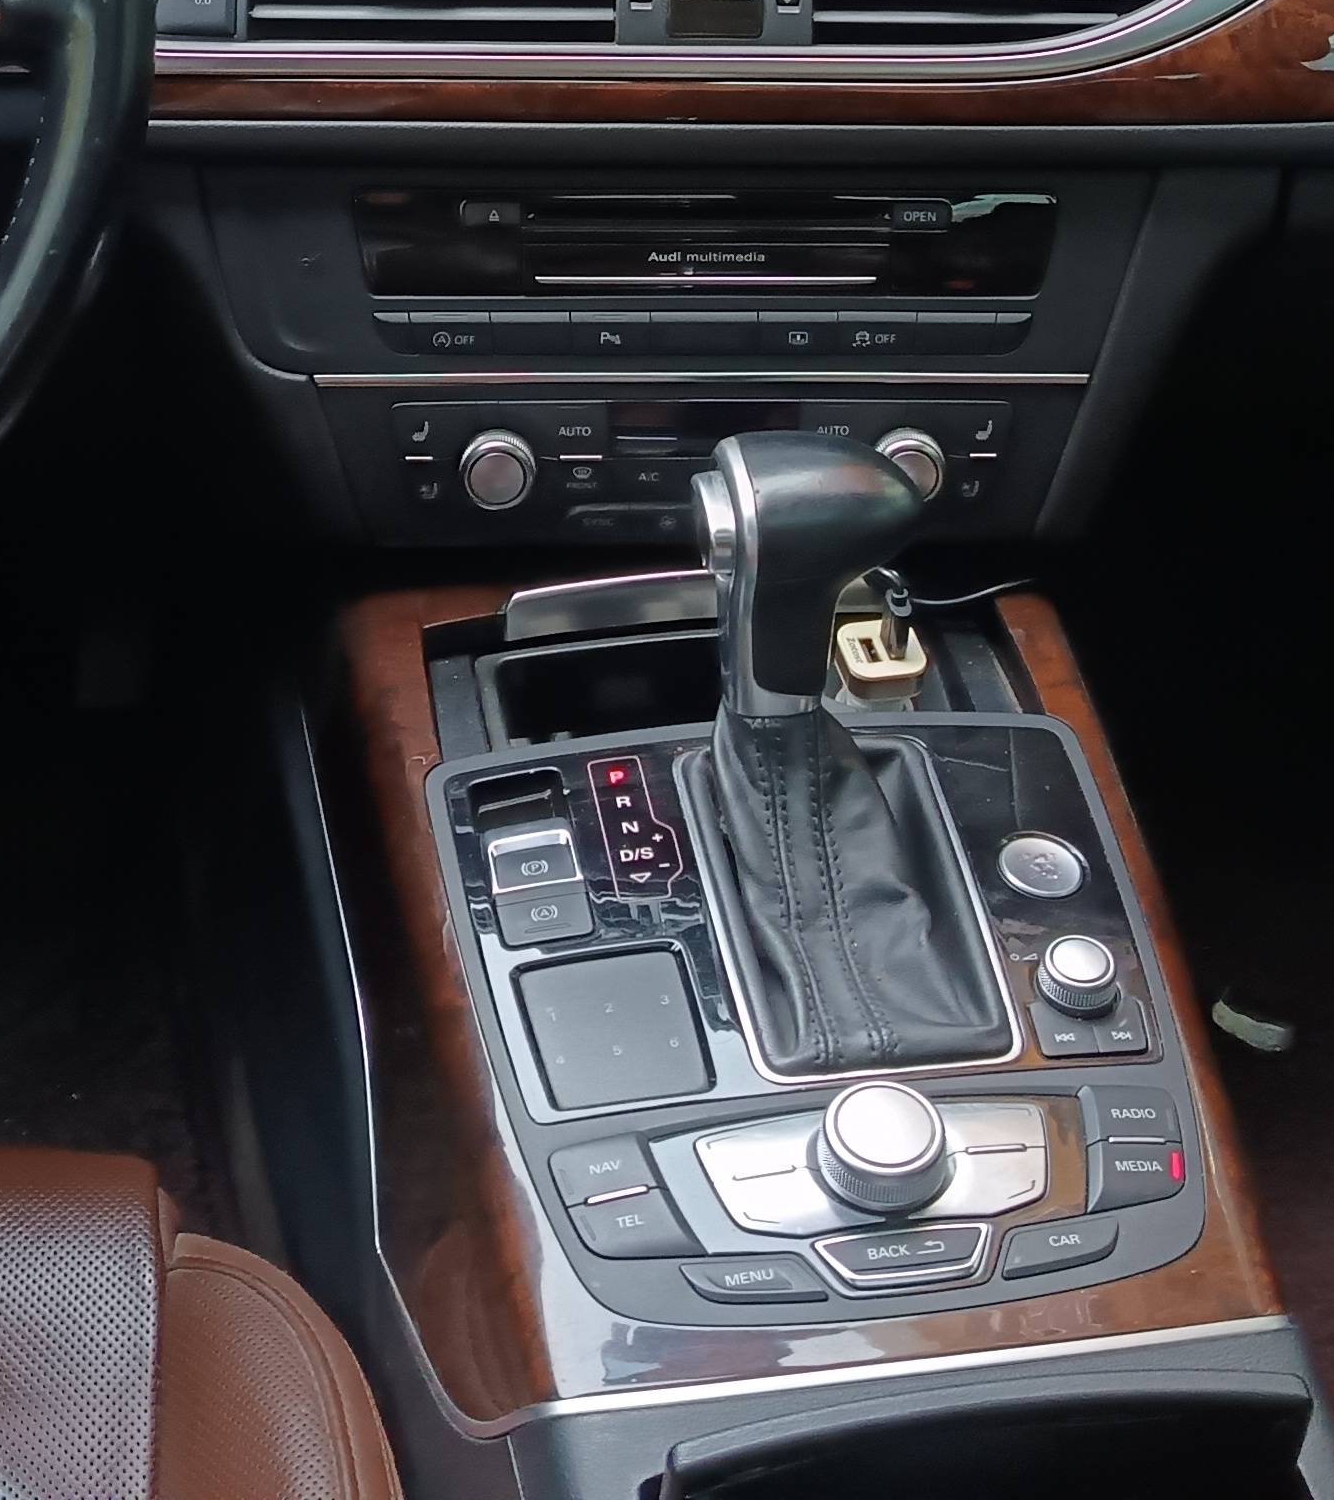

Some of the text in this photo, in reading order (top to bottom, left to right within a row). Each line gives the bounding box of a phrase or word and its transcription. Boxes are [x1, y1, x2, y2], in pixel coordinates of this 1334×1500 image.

[903, 211, 937, 222] OPEN
[647, 251, 766, 263] Audi multimedia
[454, 335, 475, 346] OFF
[874, 334, 896, 345] OFF
[558, 426, 592, 437] AUTO
[817, 425, 850, 437] AUTO
[638, 472, 660, 482] A/C
[609, 771, 624, 784] P
[616, 796, 632, 809] R
[621, 821, 640, 834] N
[619, 846, 655, 863] D/S
[660, 994, 671, 1005] 3
[603, 1003, 615, 1013] 2
[669, 1036, 679, 1048] 6
[612, 1045, 623, 1056] 5
[555, 1055, 566, 1065] 4
[1110, 1108, 1157, 1120] RADIO
[588, 1159, 622, 1176] NAV
[1114, 1160, 1163, 1172] MEDIA
[615, 1213, 645, 1230] TEL
[1048, 1233, 1082, 1248] CAR
[867, 1243, 911, 1261] BACK
[724, 1268, 775, 1288] MENU
